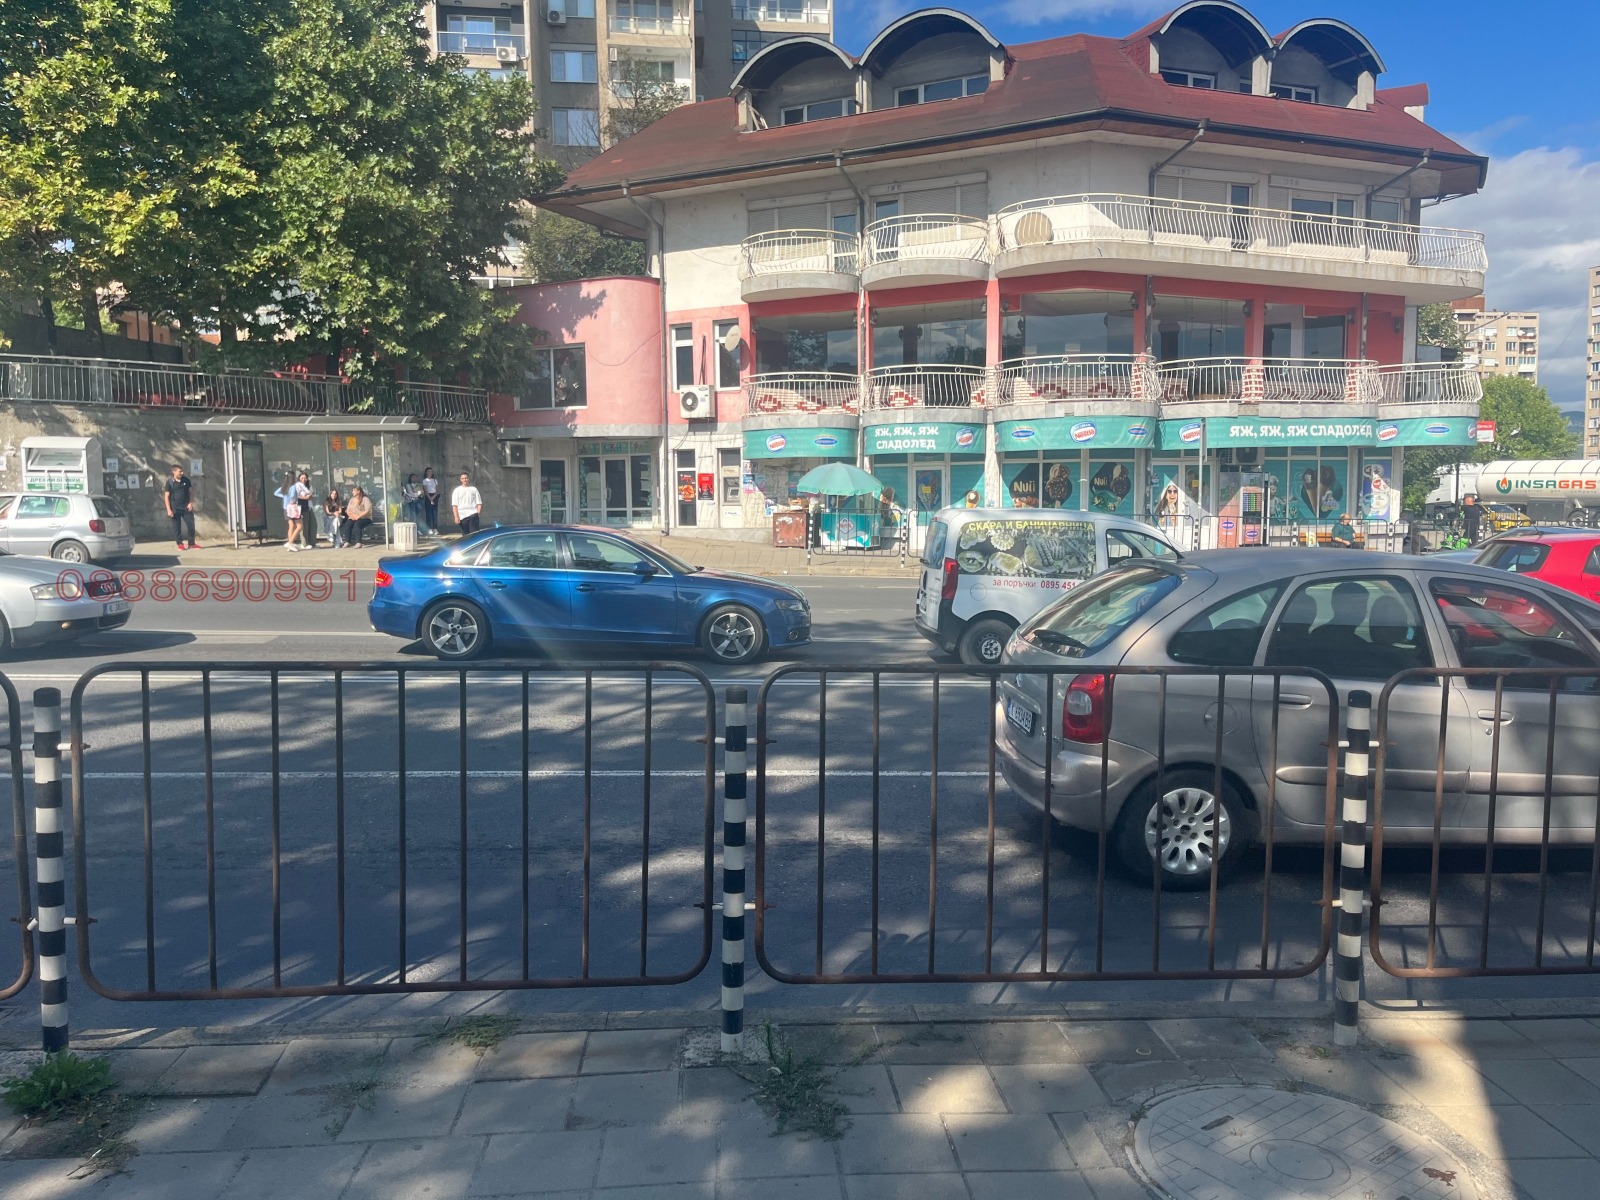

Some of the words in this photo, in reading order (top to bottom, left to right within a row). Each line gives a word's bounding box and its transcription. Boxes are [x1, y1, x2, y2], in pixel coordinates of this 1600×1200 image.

[875, 428, 892, 438] ЯЖ,
[893, 427, 916, 437] ЯЖ,
[918, 426, 939, 435] ЯЖ
[1229, 425, 1257, 439] ЯЖ,
[1259, 425, 1285, 439] ЯЖ,
[1287, 425, 1308, 437] ЯЖ
[1310, 424, 1372, 438] СЛАДОЛЕД
[876, 439, 936, 450] СЛАДОЛЕД
[1013, 480, 1036, 493] Nuii
[1515, 479, 1597, 489] INSAGAS
[968, 521, 1003, 531] СКАРА
[1005, 521, 1013, 529] И
[1040, 580, 1060, 589] 0895
